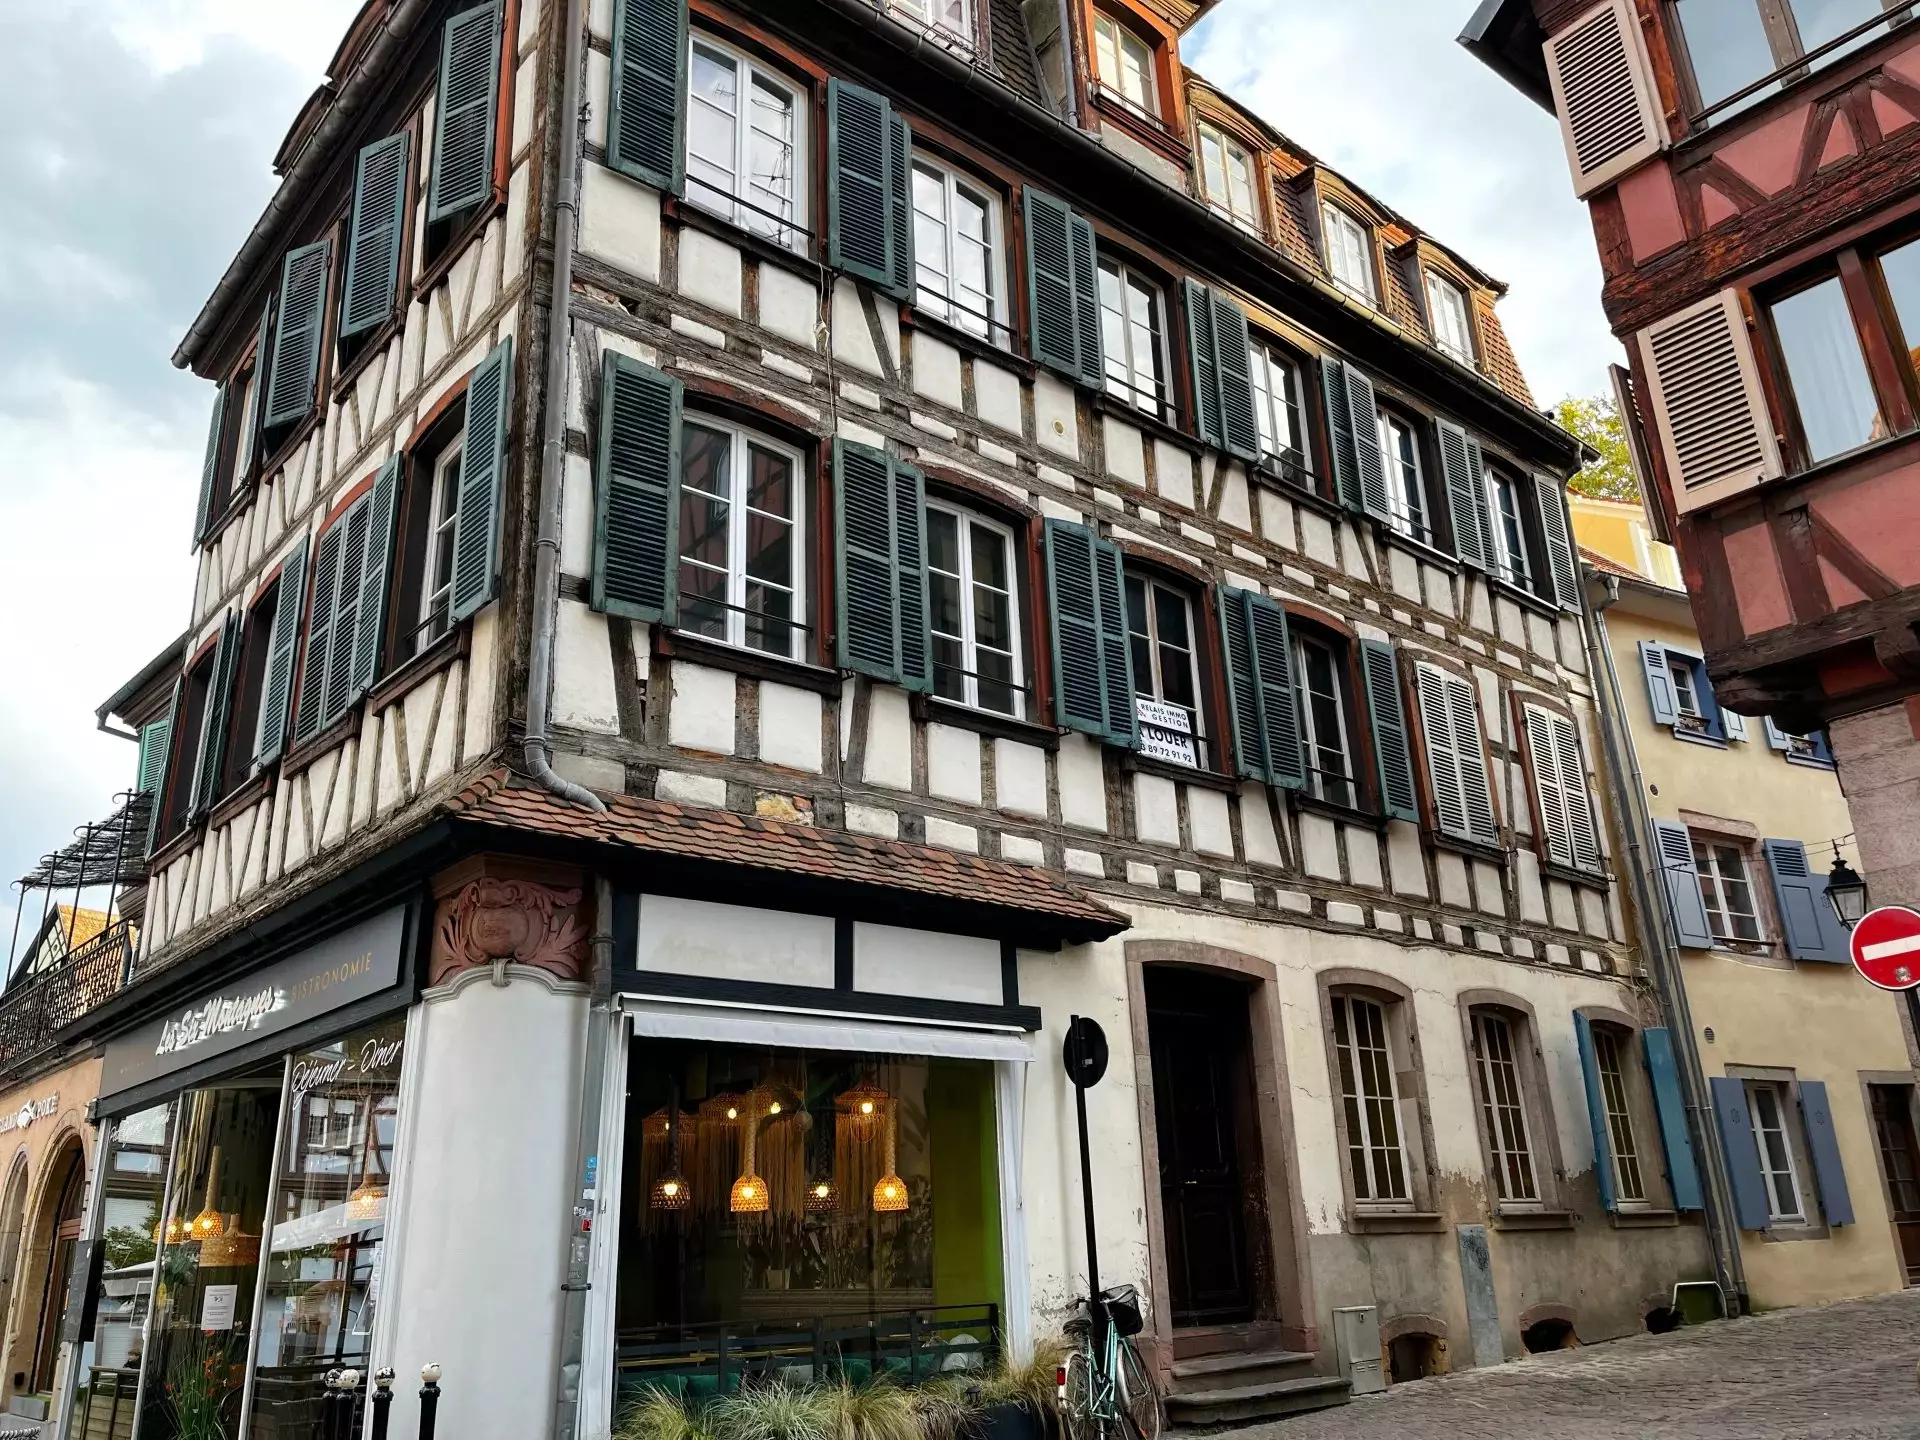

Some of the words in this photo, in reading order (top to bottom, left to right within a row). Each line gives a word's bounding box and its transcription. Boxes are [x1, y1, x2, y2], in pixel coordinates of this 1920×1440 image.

[1140, 703, 1165, 715] RELAIS
[1166, 709, 1187, 721] IMMO
[1151, 713, 1189, 729] GESTION
[1147, 726, 1188, 749] LOUER
[291, 951, 373, 1002] BISTRONOMIE
